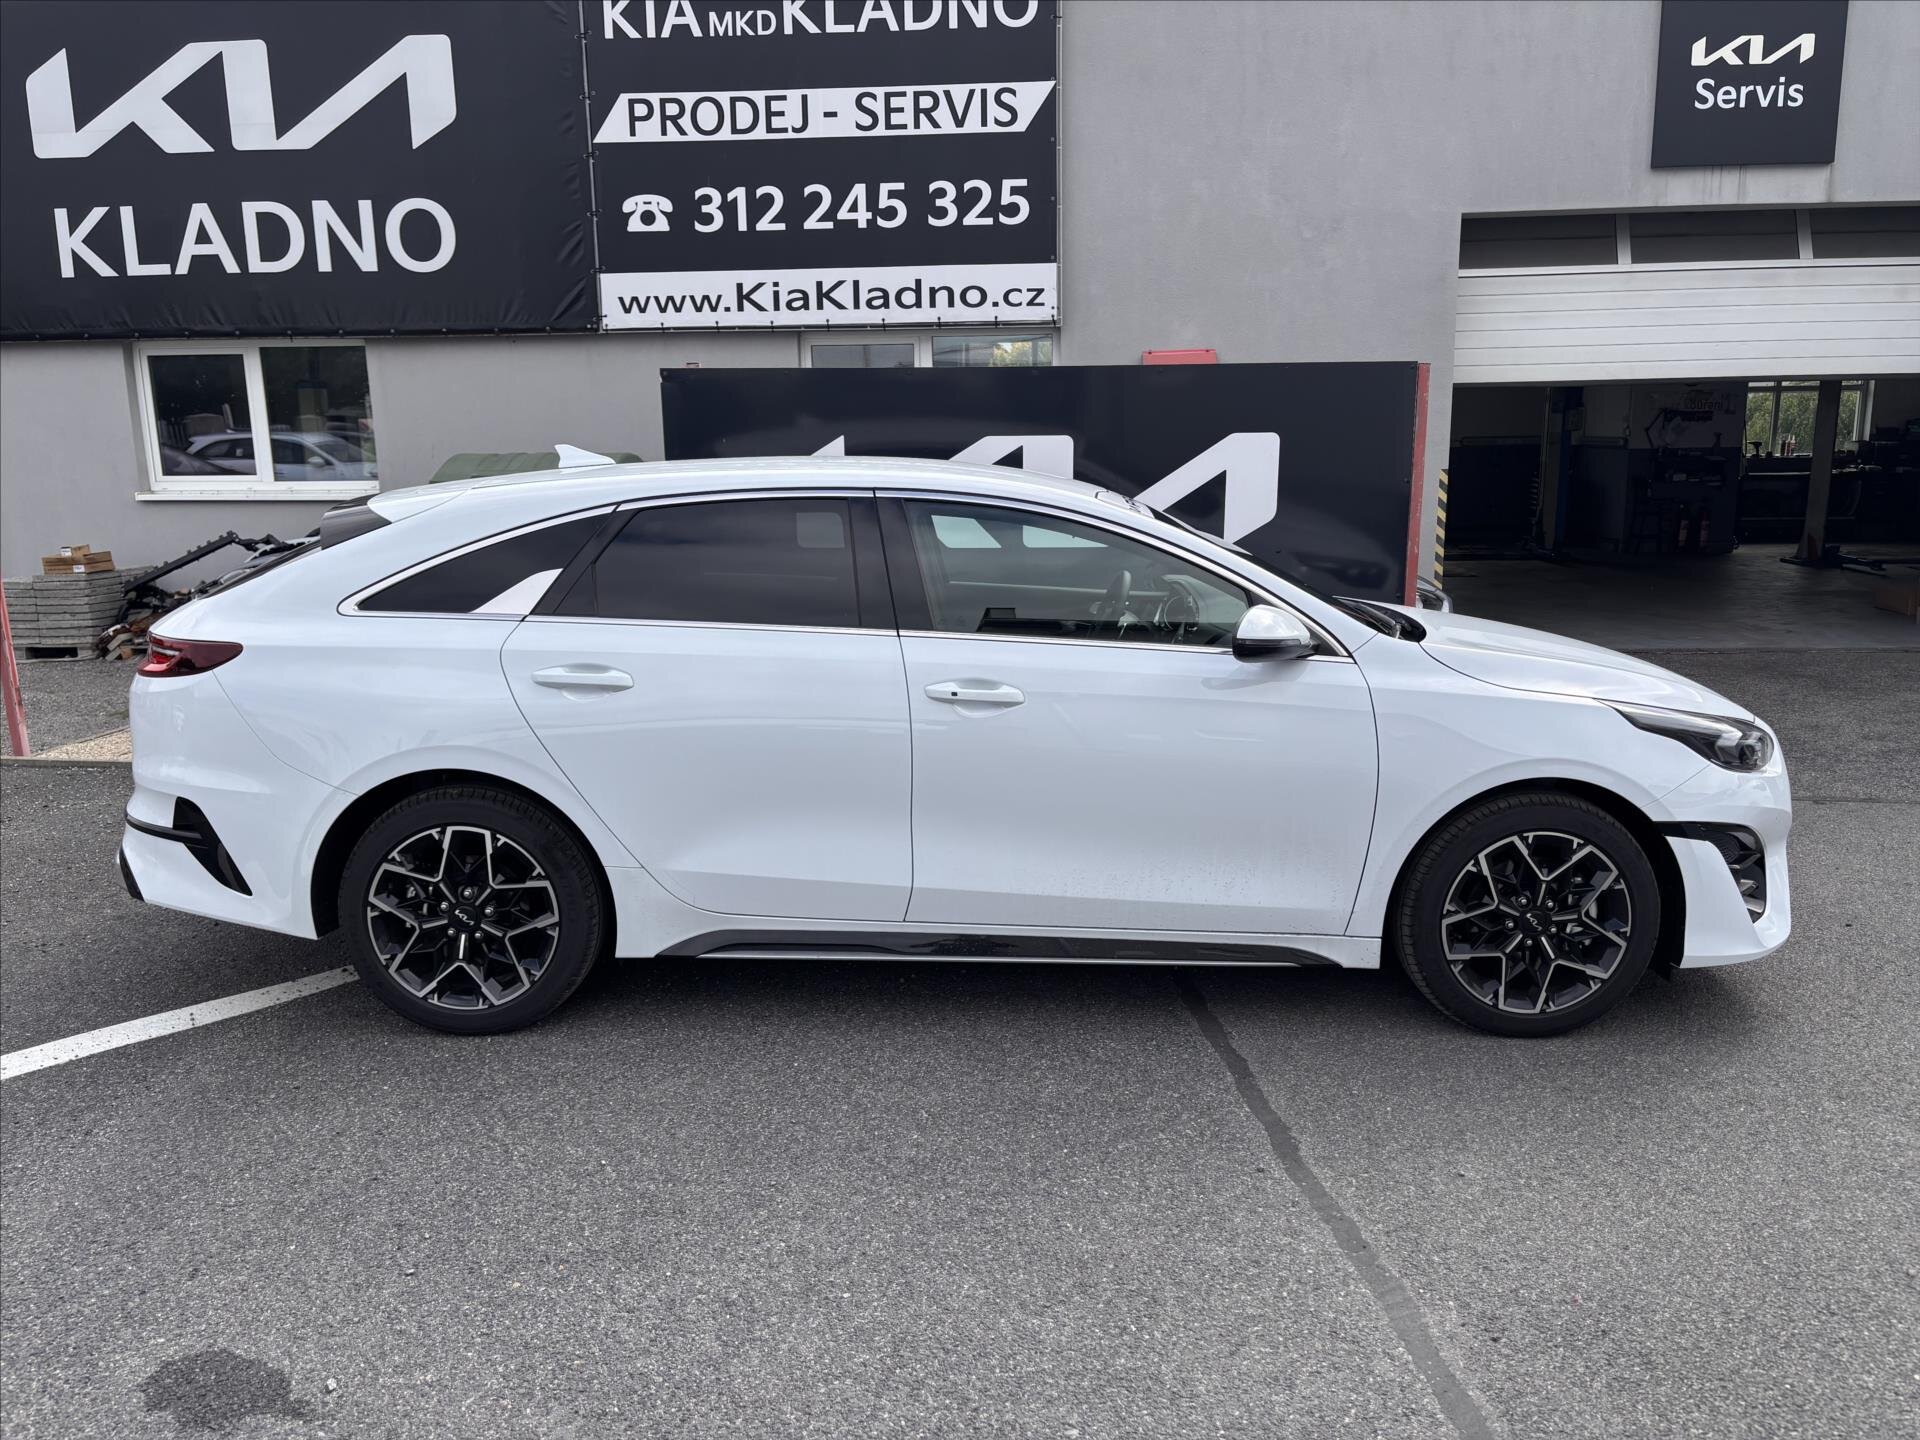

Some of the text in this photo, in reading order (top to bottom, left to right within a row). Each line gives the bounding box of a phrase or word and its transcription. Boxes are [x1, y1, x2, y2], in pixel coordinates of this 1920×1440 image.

[708, 10, 777, 37] MKD
[782, 0, 1038, 35] KLADNO
[1691, 33, 1816, 67] KIA
[26, 34, 457, 159] KIA
[627, 94, 809, 137] PRODEJ
[854, 87, 1019, 132] SERVIS
[1694, 76, 1804, 110] Servis
[694, 178, 1030, 233] 312 245 325
[53, 197, 457, 279] KLADNO
[617, 279, 1046, 315] www.KiaKladno.cz
